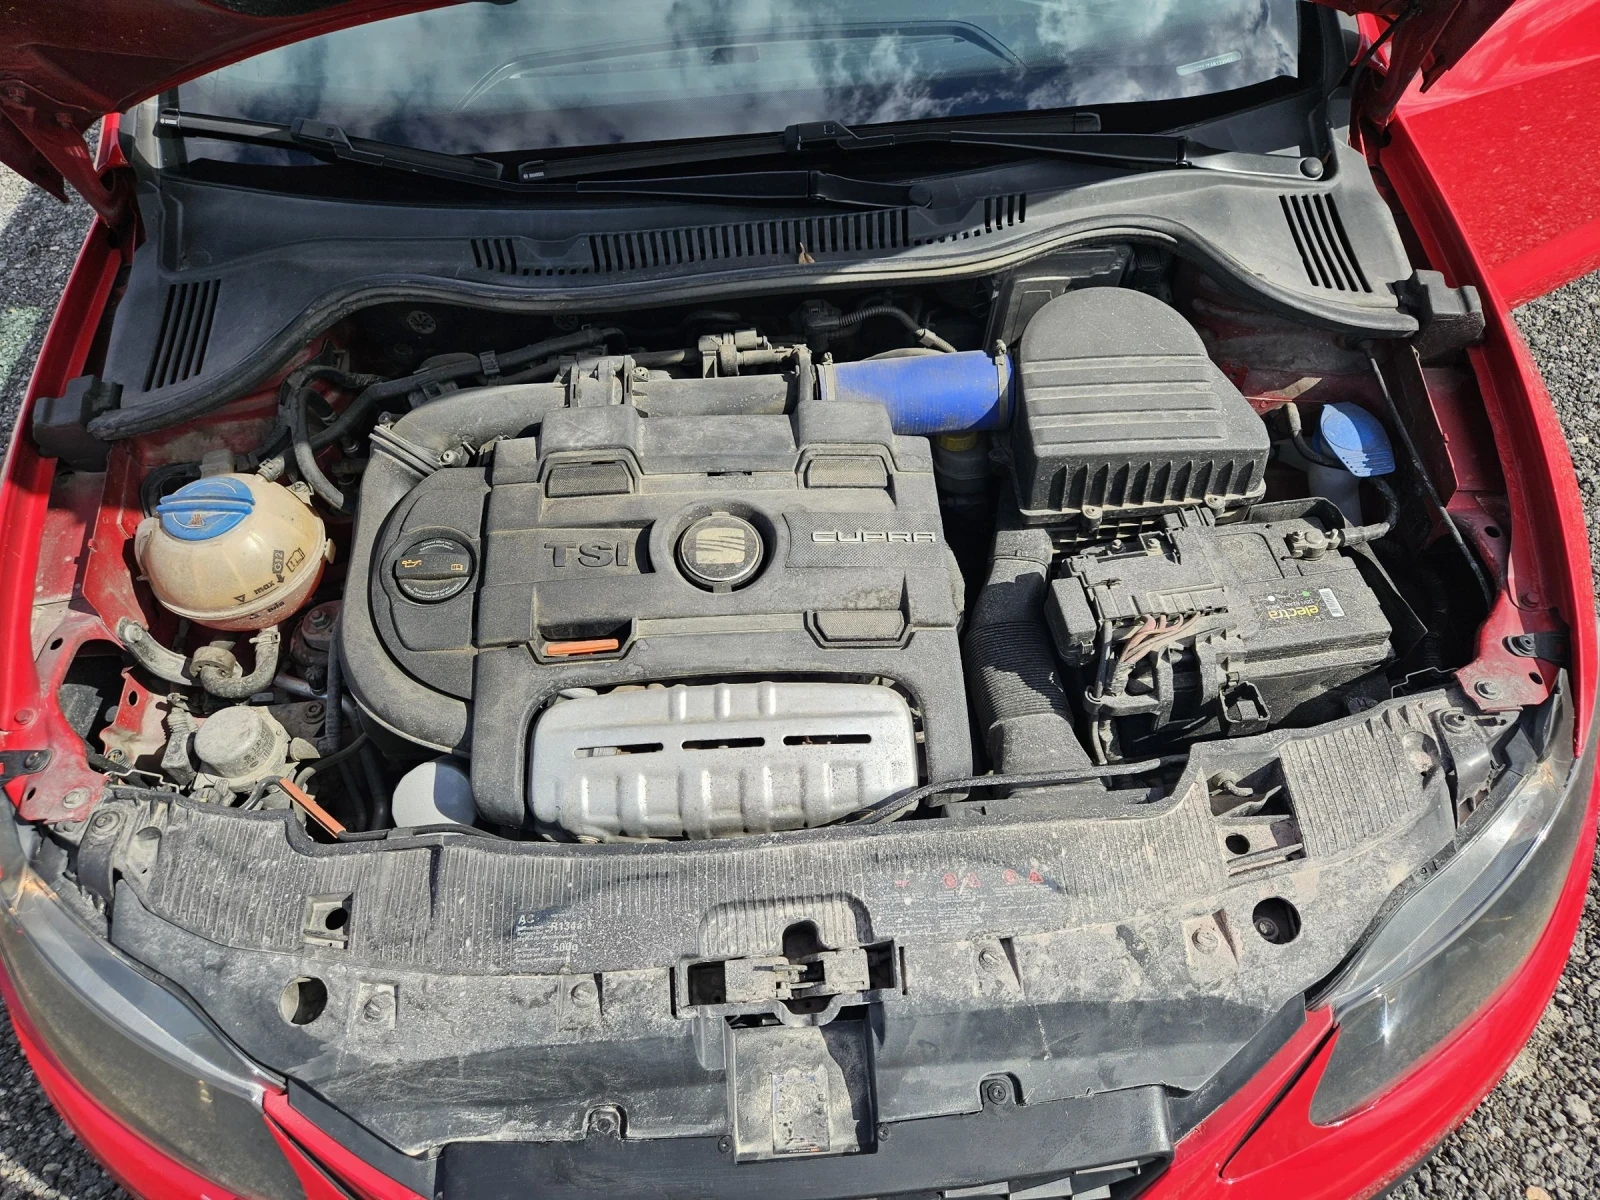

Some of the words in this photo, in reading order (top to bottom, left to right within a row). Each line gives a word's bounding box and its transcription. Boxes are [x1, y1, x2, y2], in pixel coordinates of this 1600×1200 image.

[811, 531, 937, 543] CUPRA
[544, 540, 629, 567] TSI
[254, 580, 275, 595] max
[1268, 604, 1320, 620] electra
